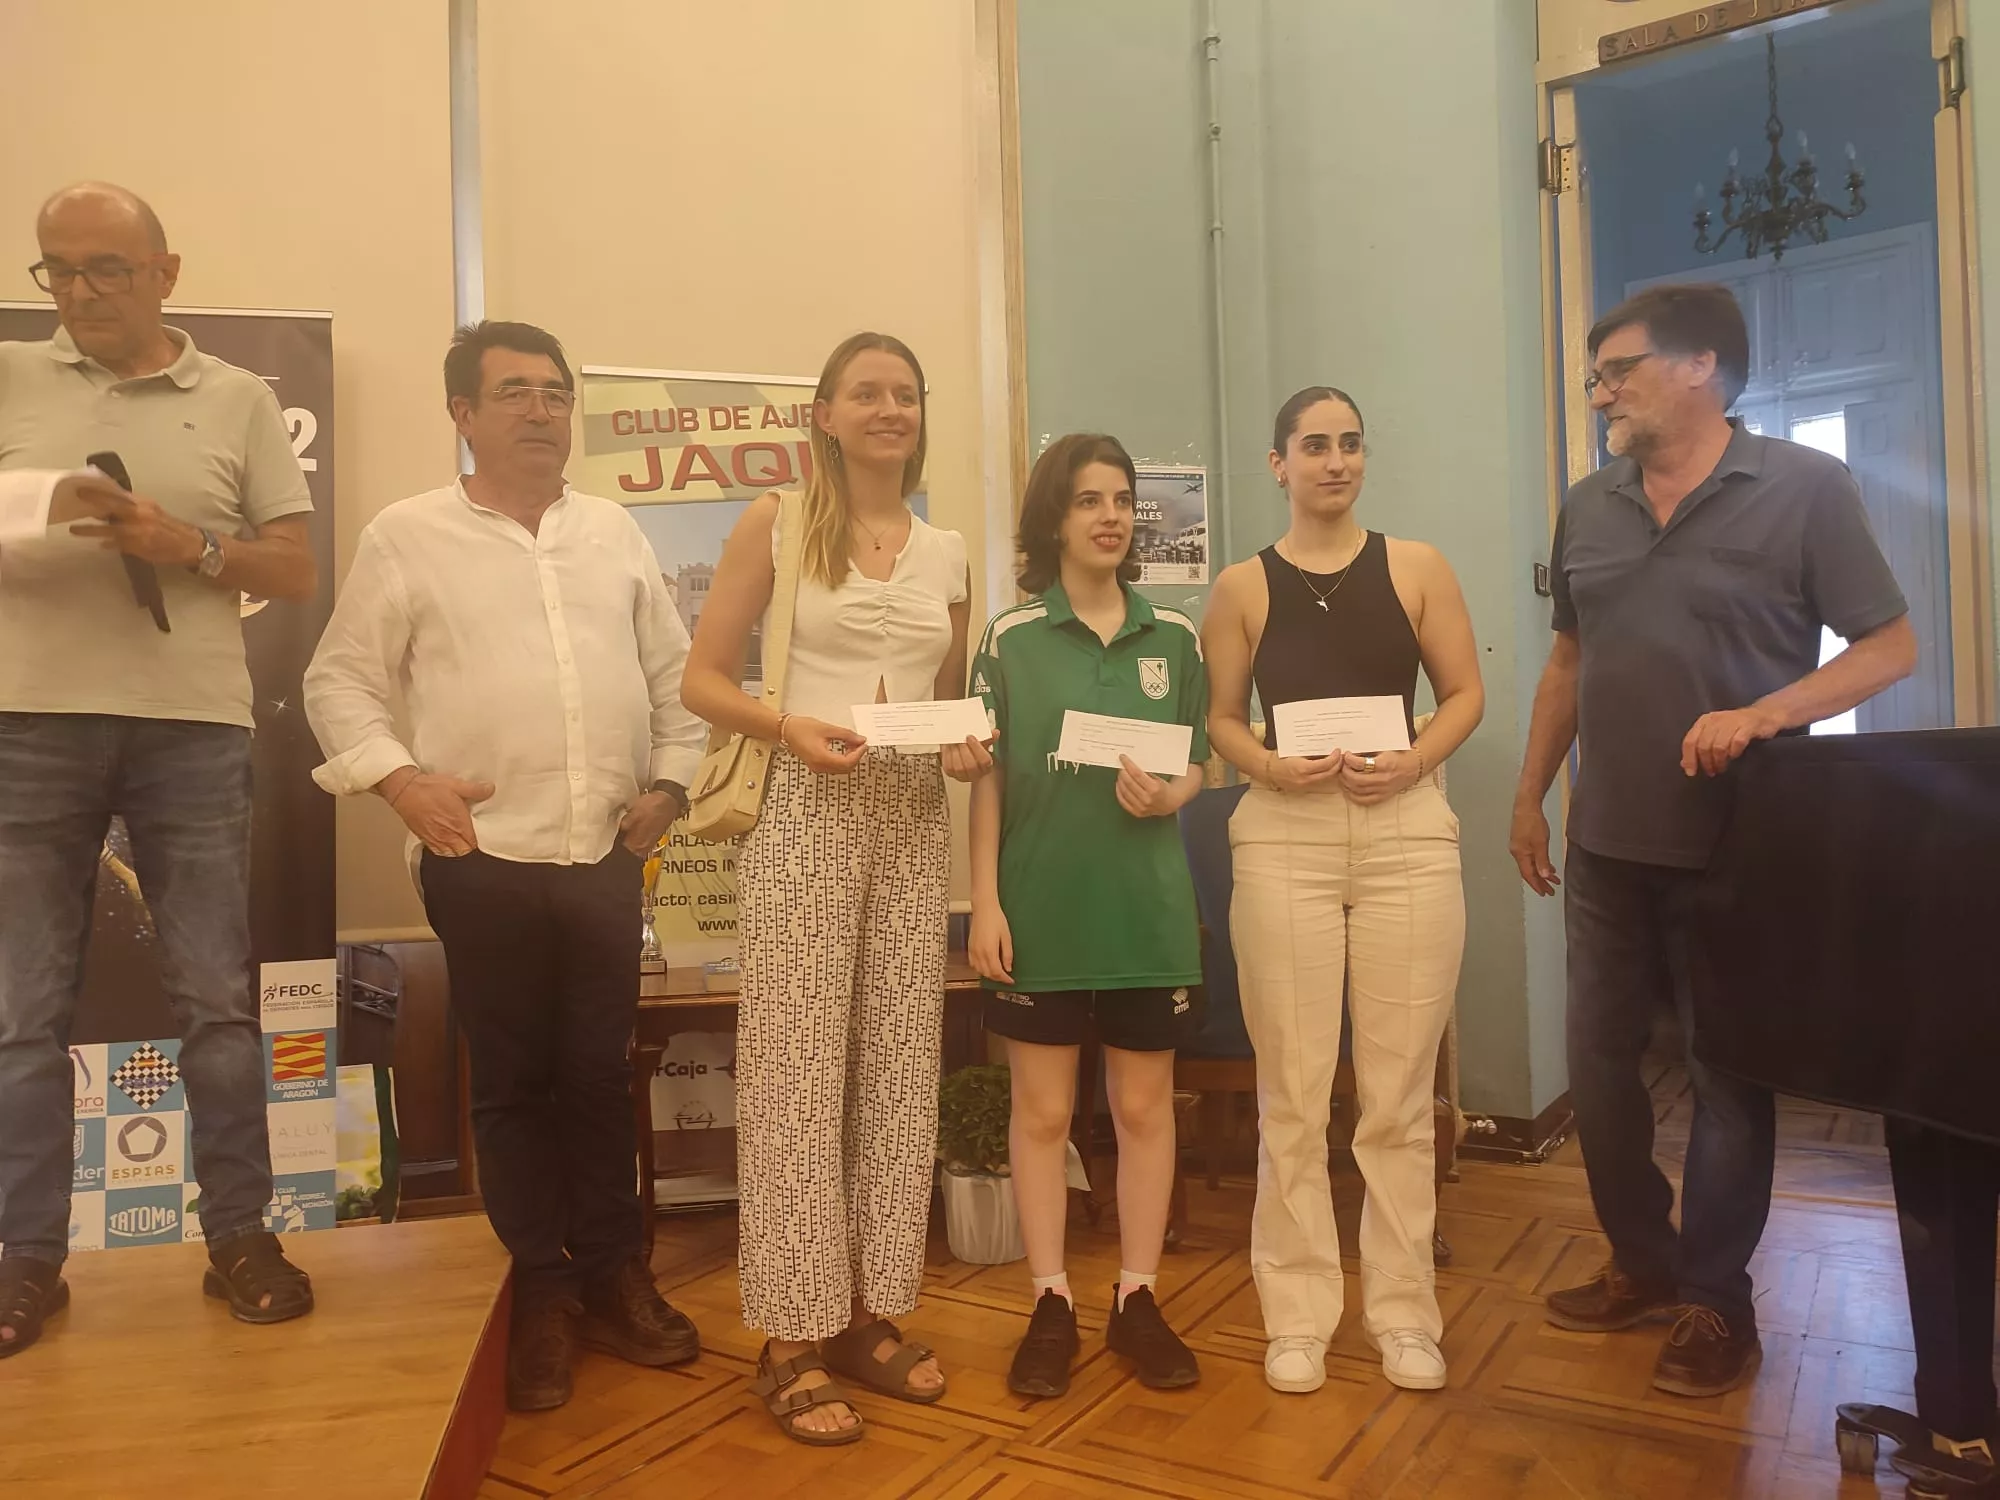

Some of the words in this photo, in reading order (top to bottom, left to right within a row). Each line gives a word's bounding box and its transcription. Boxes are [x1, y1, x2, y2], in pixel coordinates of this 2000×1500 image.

[1604, 24, 1680, 58] SALA
[1693, 7, 1730, 34] DE
[611, 408, 700, 436] CLUB
[708, 405, 752, 431] DE
[280, 983, 322, 997] FEDC
[317, 1078, 329, 1087] DE
[111, 1164, 175, 1180] ESPIAS
[109, 1206, 176, 1233] TATOMA
